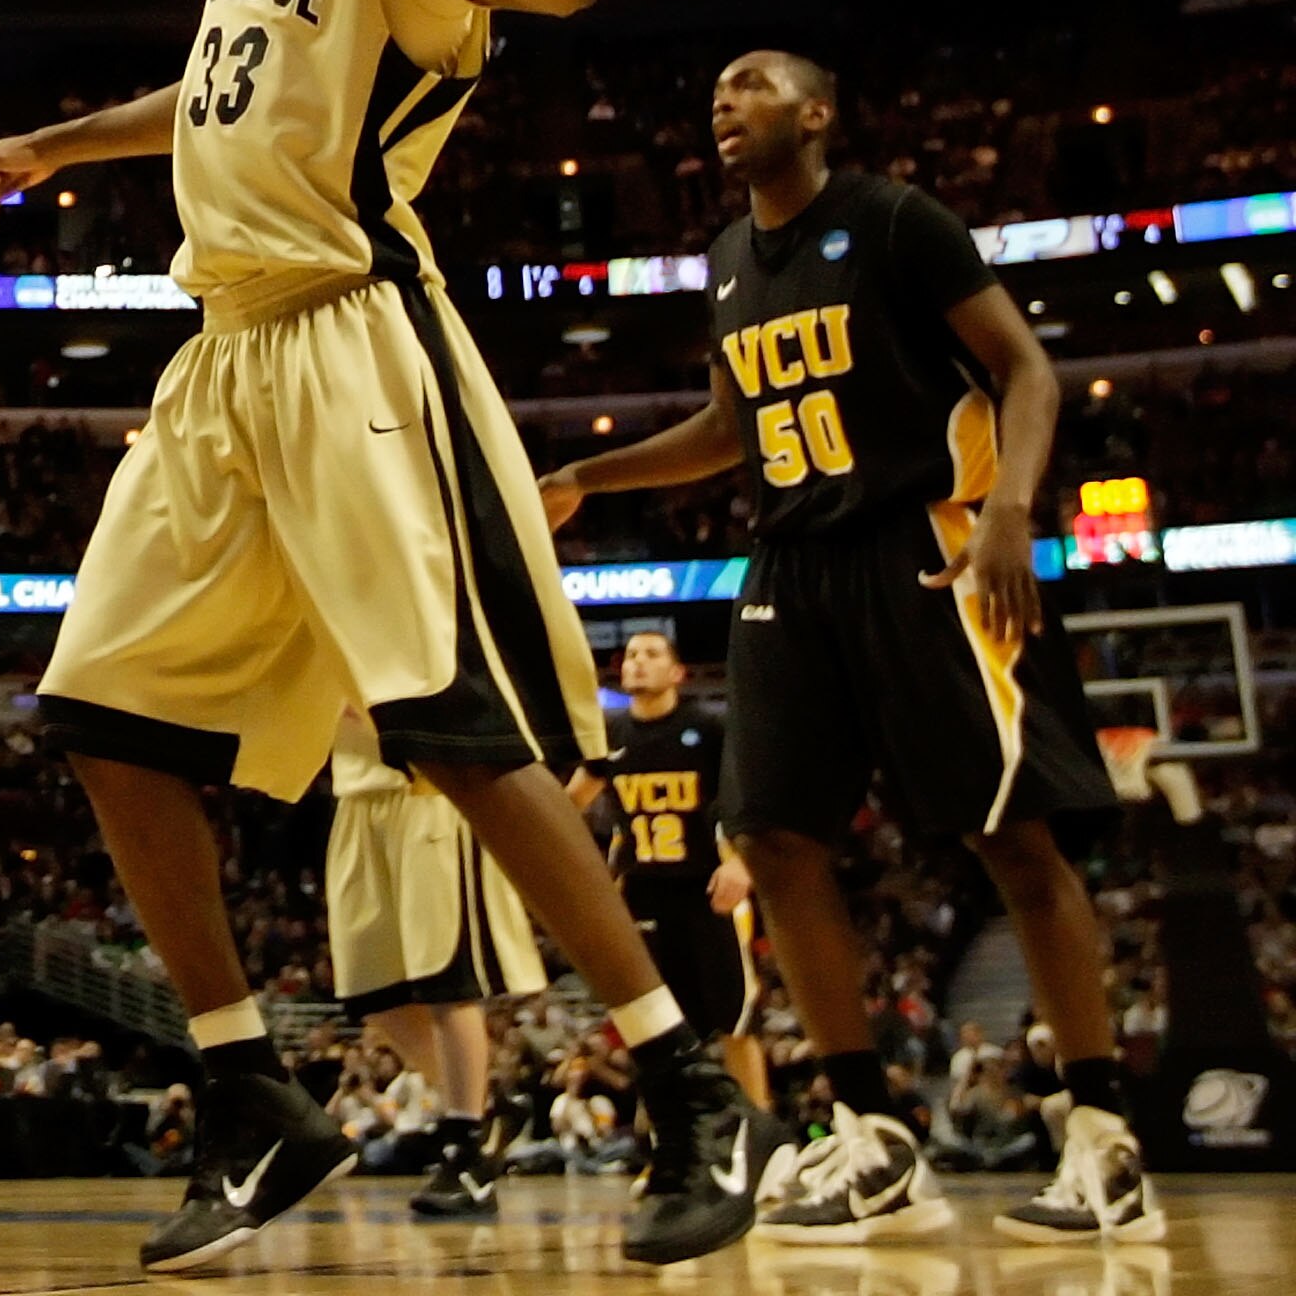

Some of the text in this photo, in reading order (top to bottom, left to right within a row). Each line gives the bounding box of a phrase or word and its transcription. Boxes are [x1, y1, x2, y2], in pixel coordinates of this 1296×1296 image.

[189, 27, 270, 126] 33
[722, 304, 854, 398] VCU
[756, 390, 855, 488] 50
[612, 770, 699, 815] VCU
[631, 814, 688, 863] 12
